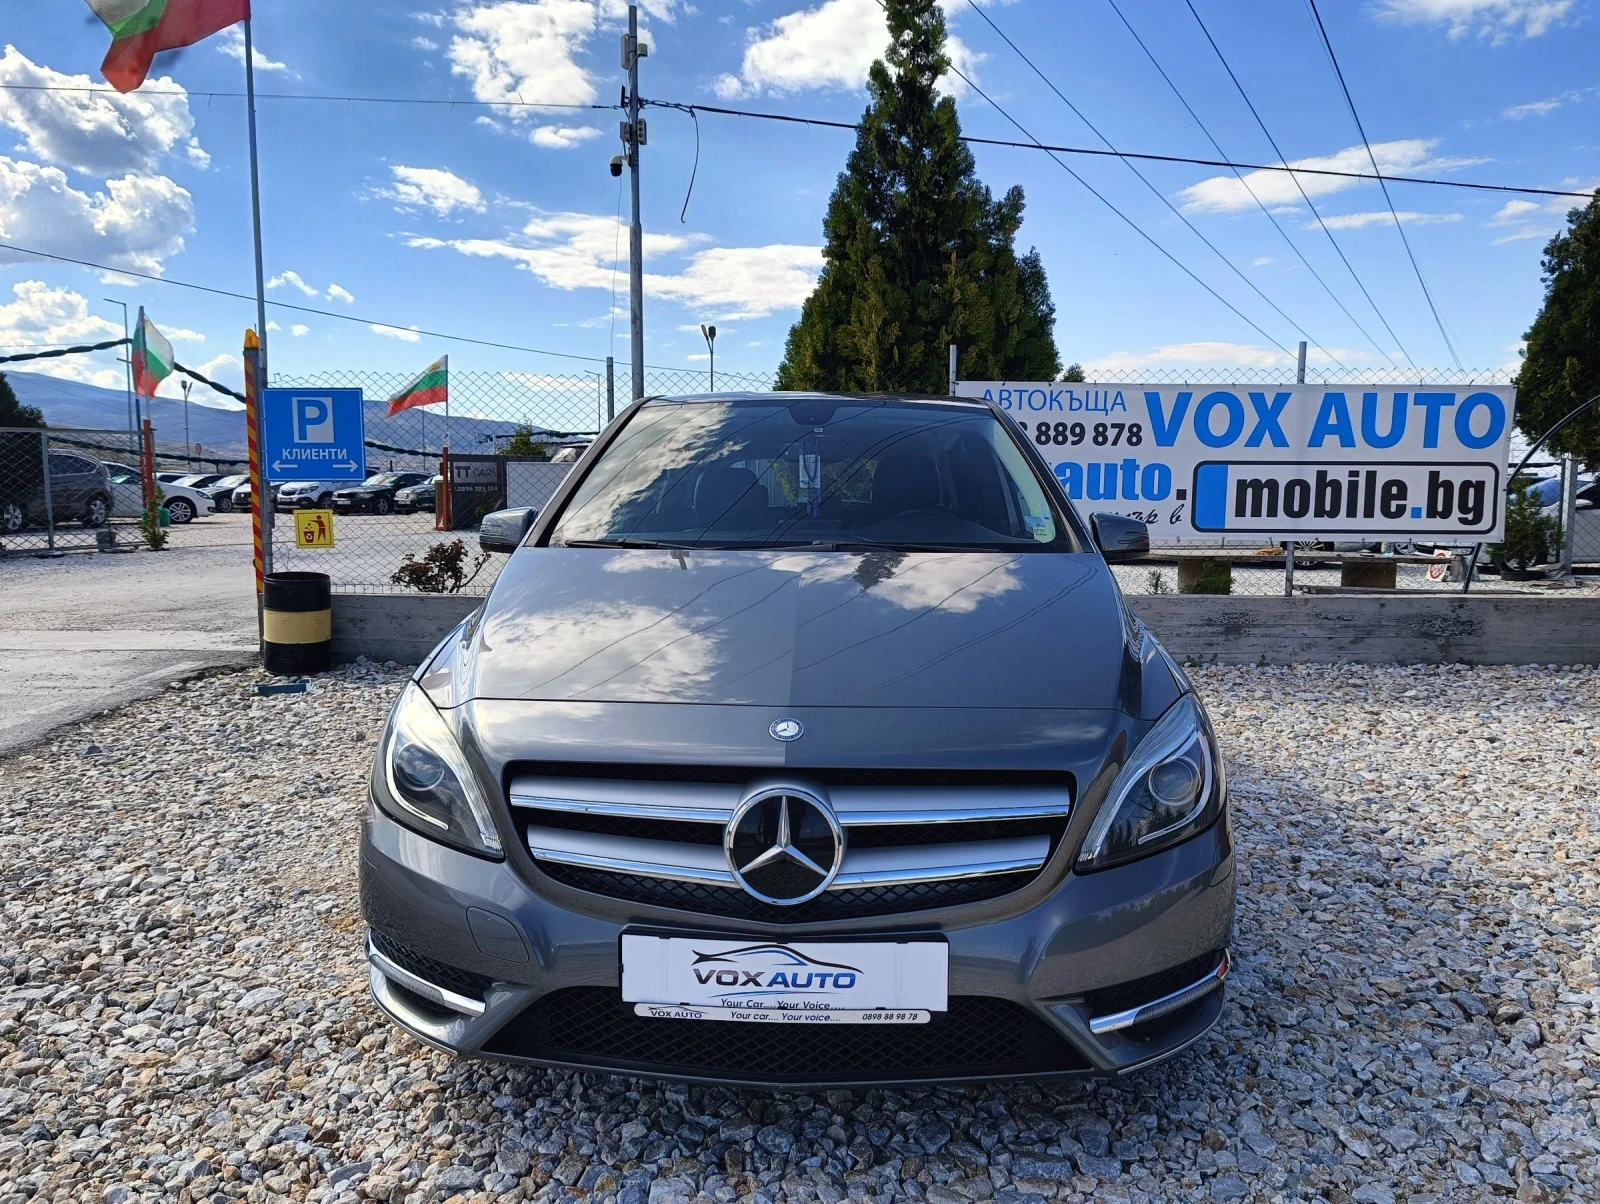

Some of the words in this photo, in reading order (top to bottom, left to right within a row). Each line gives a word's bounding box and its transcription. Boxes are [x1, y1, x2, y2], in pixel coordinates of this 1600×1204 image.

[297, 399, 328, 441] P
[1144, 391, 1292, 448] VOX
[1307, 392, 1506, 449] AUTO
[1035, 421, 1086, 446] 889
[1092, 423, 1143, 447] 878
[282, 448, 348, 460] КЛИЕНТИ
[455, 465, 471, 478] TT
[472, 466, 496, 477] CARS
[1234, 470, 1486, 526] mobile.bg
[693, 968, 765, 987] VOX
[766, 972, 856, 989] AUTO
[721, 998, 744, 1008] Your
[674, 1011, 702, 1019] AUTO
[731, 1011, 751, 1020] Your
[782, 1012, 802, 1021] Your
[862, 1013, 881, 1021] 0898
[883, 1013, 894, 1021] 88
[896, 1013, 906, 1021] 98
